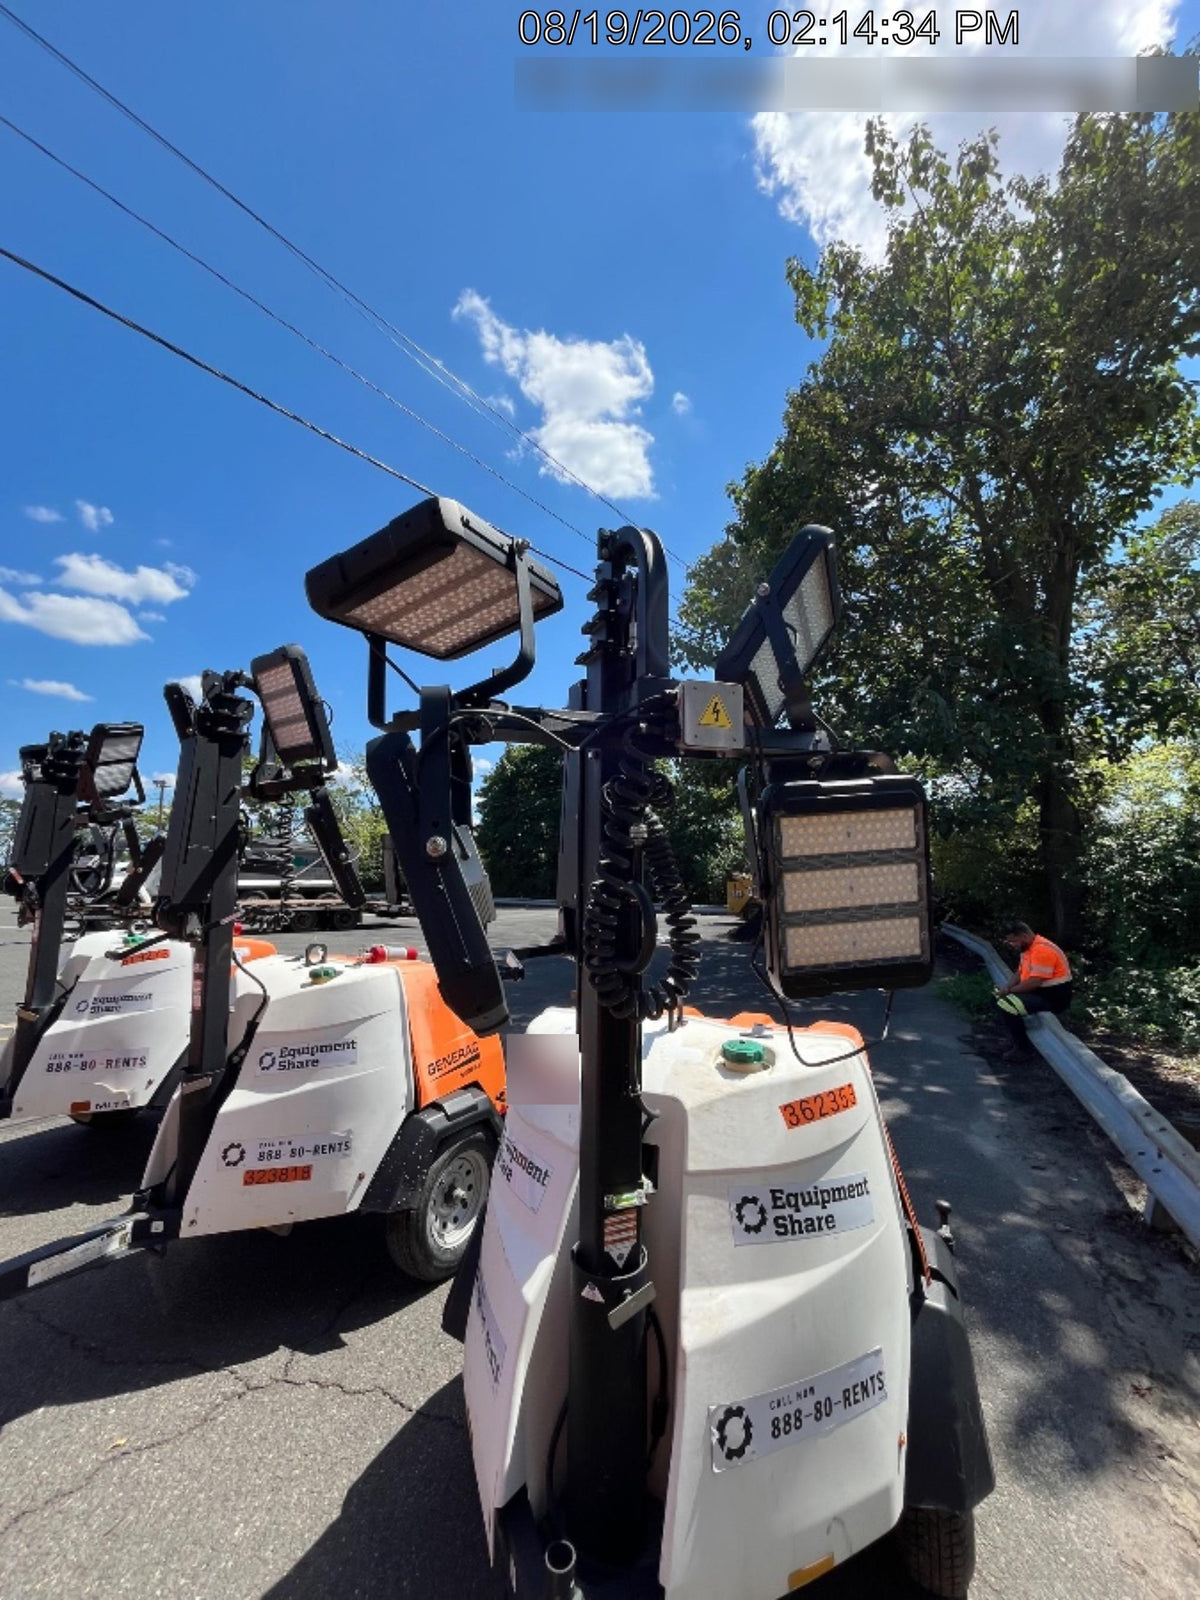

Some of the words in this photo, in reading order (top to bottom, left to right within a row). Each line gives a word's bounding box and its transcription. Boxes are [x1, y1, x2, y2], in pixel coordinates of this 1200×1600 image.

[278, 1039, 357, 1060] Equipment
[428, 1041, 479, 1076] GENERAC
[277, 1059, 320, 1071] Share
[244, 1165, 312, 1185] 323818
[769, 1177, 870, 1213] Equipment
[773, 1213, 836, 1236] Share
[770, 1371, 885, 1439] 888-80-RENTS
